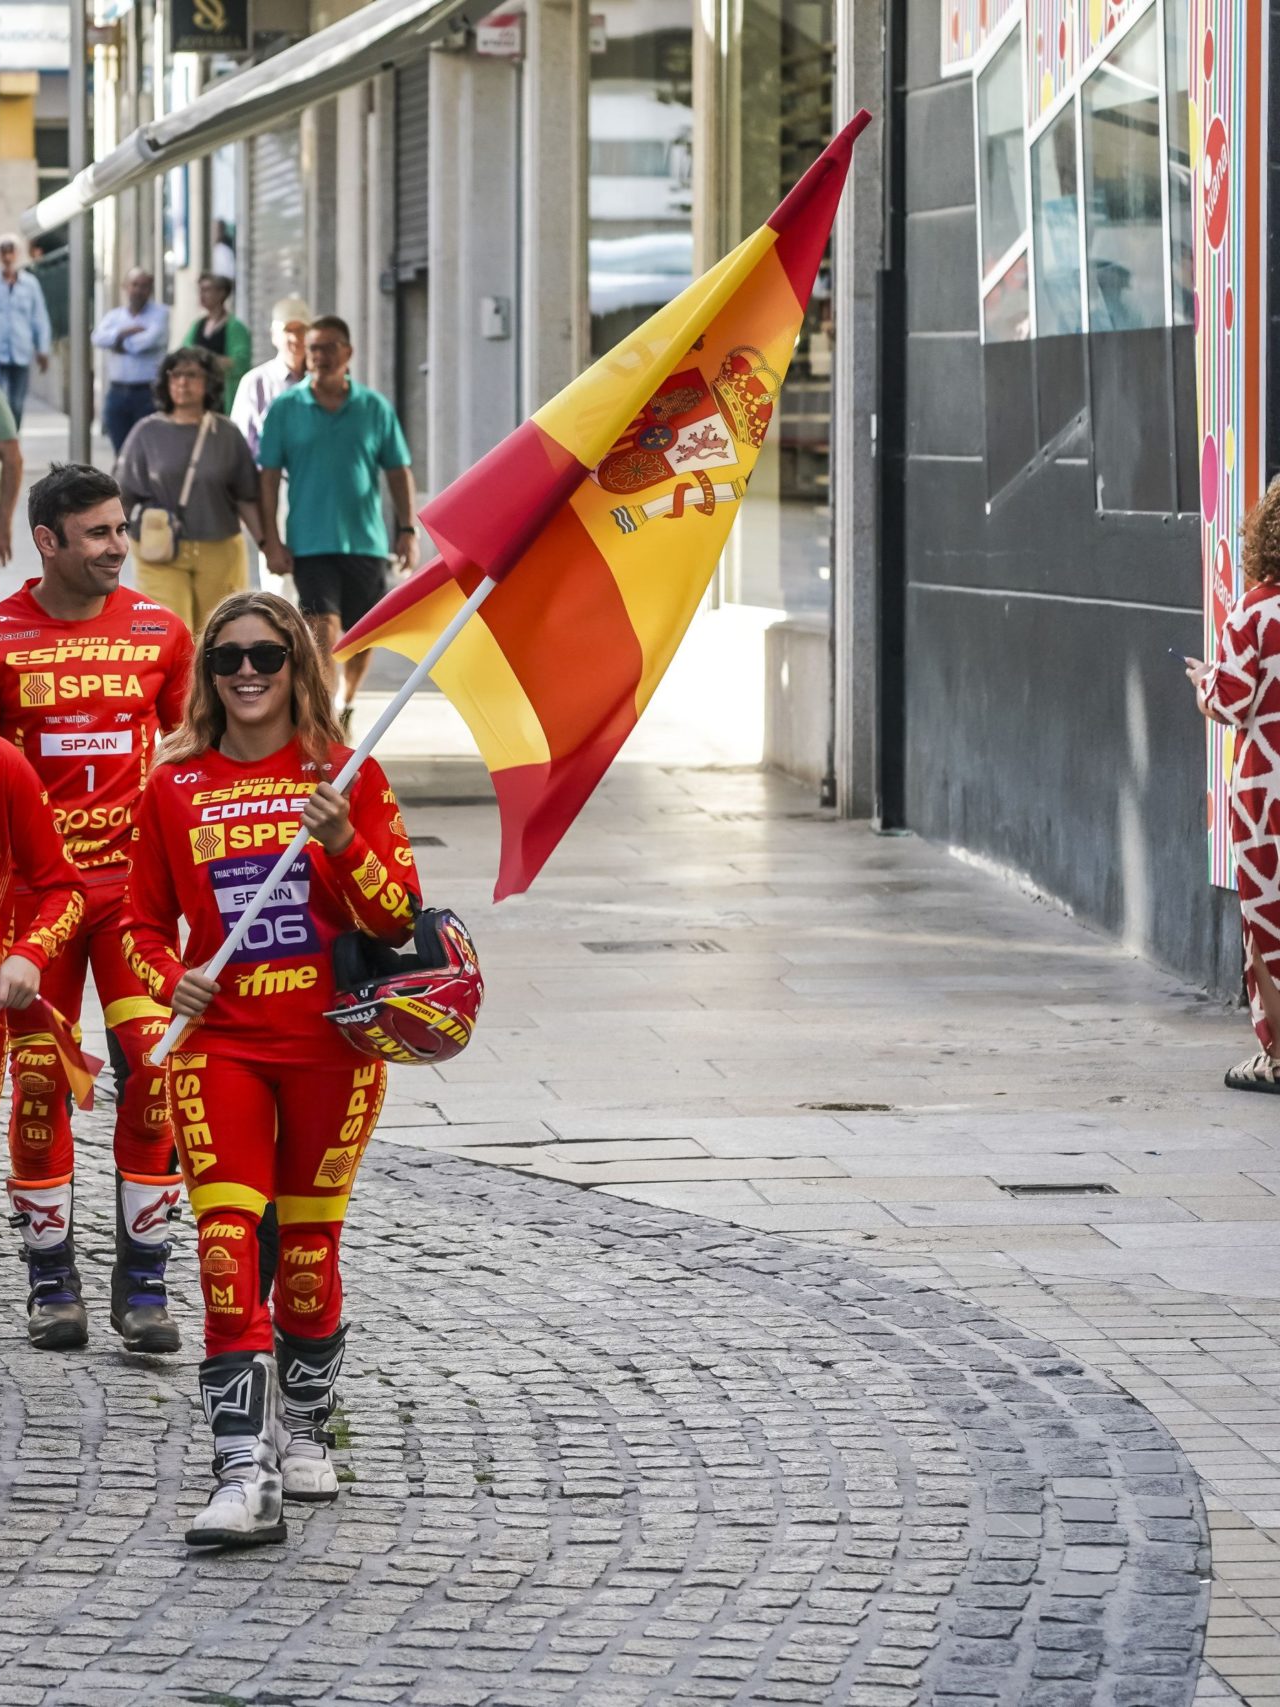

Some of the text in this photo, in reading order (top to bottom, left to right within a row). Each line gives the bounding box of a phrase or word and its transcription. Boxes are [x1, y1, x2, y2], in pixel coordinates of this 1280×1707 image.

[1205, 143, 1228, 227] xiana
[56, 636, 108, 647] TEAM
[5, 639, 161, 666] ESPAÑA
[59, 675, 144, 699] SPEA
[61, 738, 118, 751] SPAIN
[84, 765, 95, 792] 1
[233, 776, 275, 787] TEAM
[192, 778, 320, 806] ESPAÑA
[201, 798, 310, 822] COMAS
[230, 821, 323, 849] SPE
[214, 866, 258, 879] TRIAL NATIONS
[291, 862, 305, 873] IM
[233, 888, 292, 906] SPIN
[380, 882, 415, 930] SP
[235, 963, 319, 997] rfme
[335, 1007, 377, 1025] rfme
[406, 1001, 436, 1020] hebo
[141, 1020, 170, 1035] rfm
[17, 1050, 57, 1066] rfme
[340, 1063, 377, 1143] SPE
[176, 1074, 217, 1177] SPEA
[202, 1221, 245, 1240] rfme
[283, 1246, 328, 1265] rfme
[209, 1306, 244, 1314] COMAS
